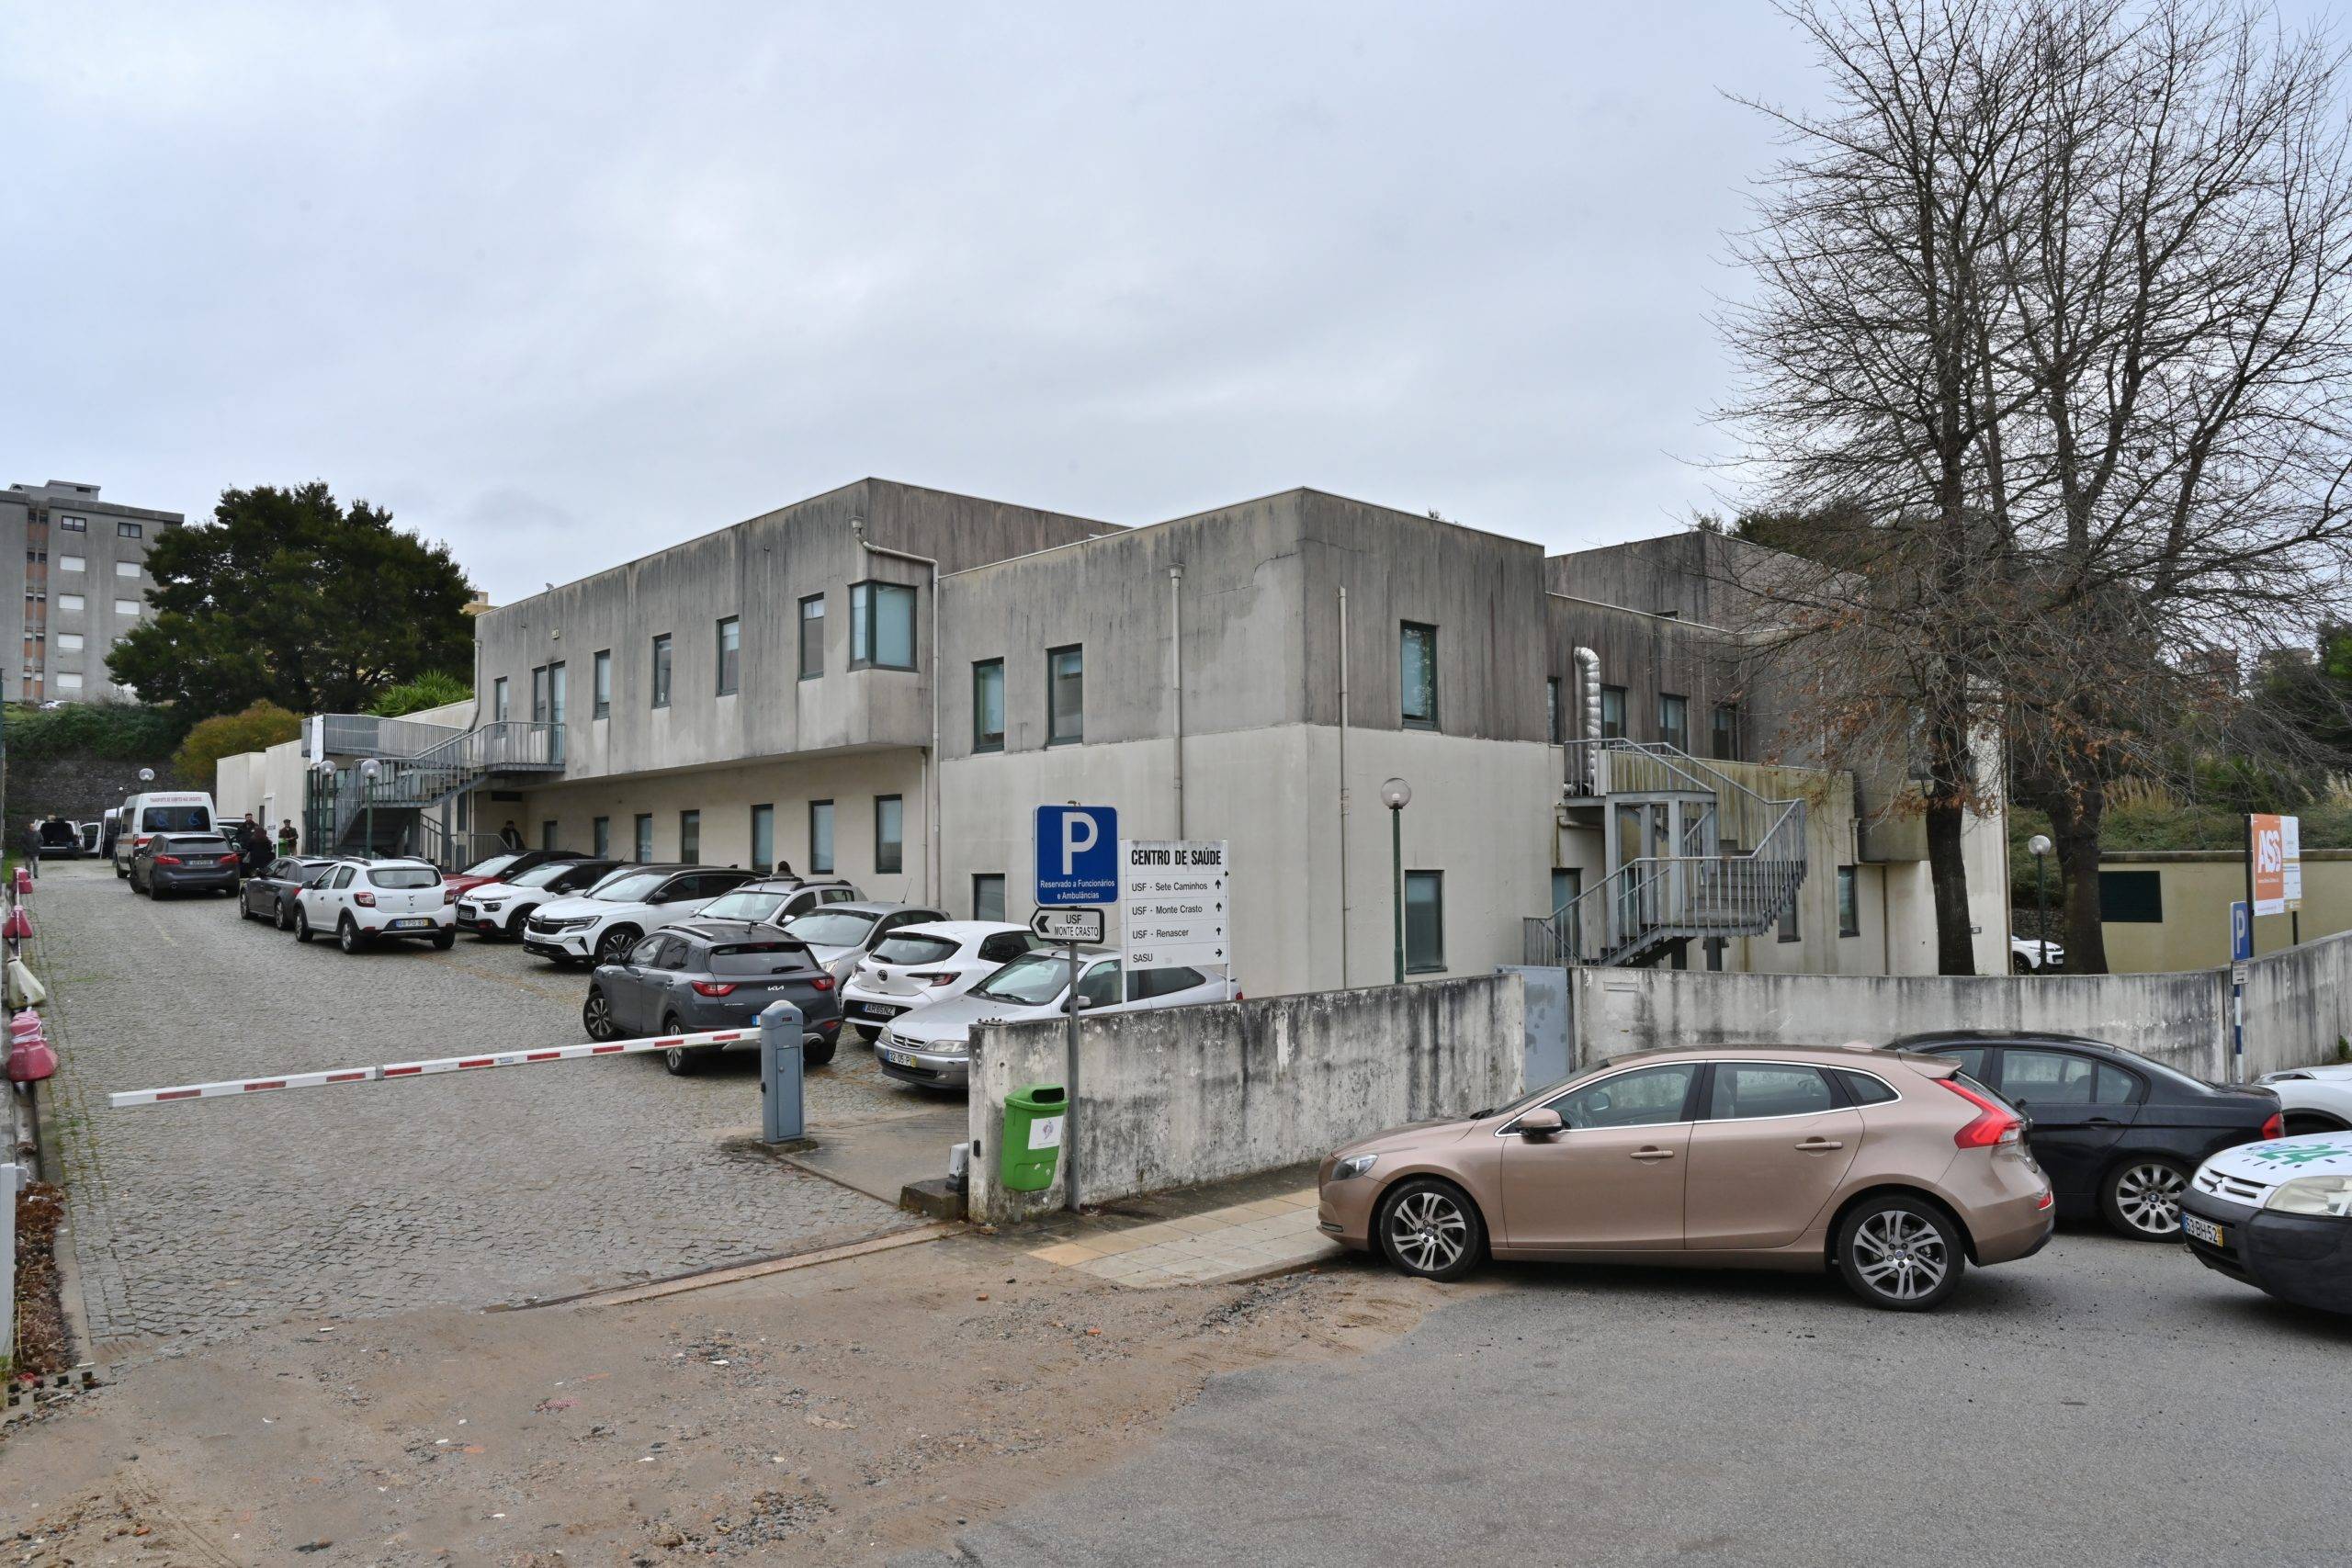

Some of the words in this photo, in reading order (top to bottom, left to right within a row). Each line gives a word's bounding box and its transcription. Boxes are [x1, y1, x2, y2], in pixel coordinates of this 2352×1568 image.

[1062, 811, 1098, 874] P
[1131, 850, 1170, 865] CENTRO
[1175, 850, 1187, 865] DE
[1191, 847, 1221, 865] SAÚDE
[1040, 879, 1071, 888] Reservado
[1078, 878, 1115, 887] Funcionários
[1131, 883, 1147, 891] USF
[1155, 882, 1171, 891] Sete
[1173, 882, 1208, 891] Caminhos
[1061, 891, 1100, 899] Ambulâncias
[1132, 906, 1147, 915] USF
[1156, 906, 1178, 914] Monte
[1180, 905, 1203, 913] Crasto
[1066, 914, 1082, 924] USF
[1055, 926, 1073, 936] MONTE
[1075, 926, 1099, 937] CRASTO
[1132, 930, 1148, 939] USF
[1156, 929, 1189, 938] Renascer
[2235, 910, 2245, 953] P
[1133, 953, 1153, 963] SASU
